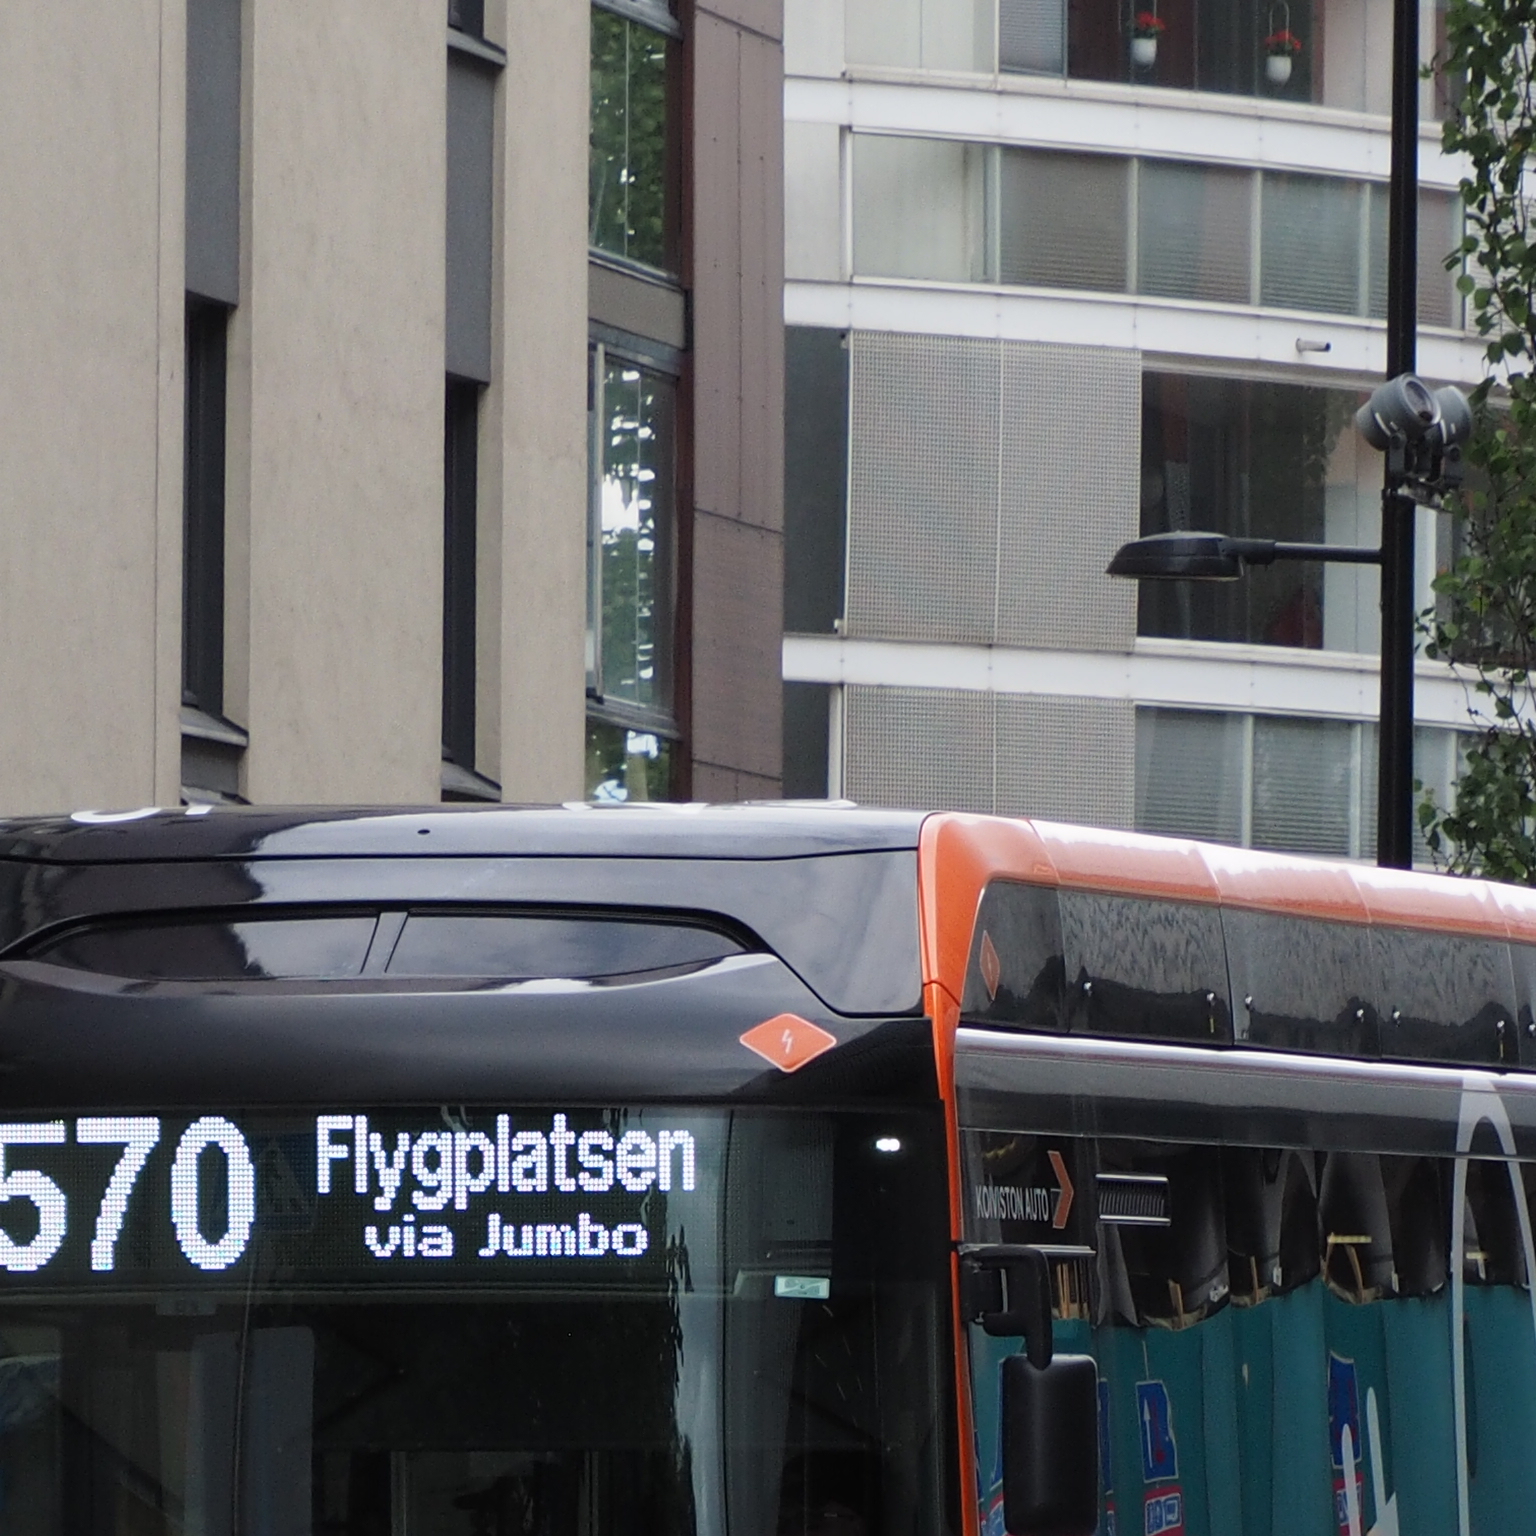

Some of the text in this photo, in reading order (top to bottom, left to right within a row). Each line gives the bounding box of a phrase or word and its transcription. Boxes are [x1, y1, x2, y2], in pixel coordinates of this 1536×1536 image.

[316, 1113, 696, 1211] Flygplatsen
[1025, 1187, 1050, 1222] AUTO
[364, 1212, 649, 1257] via Jumbo
